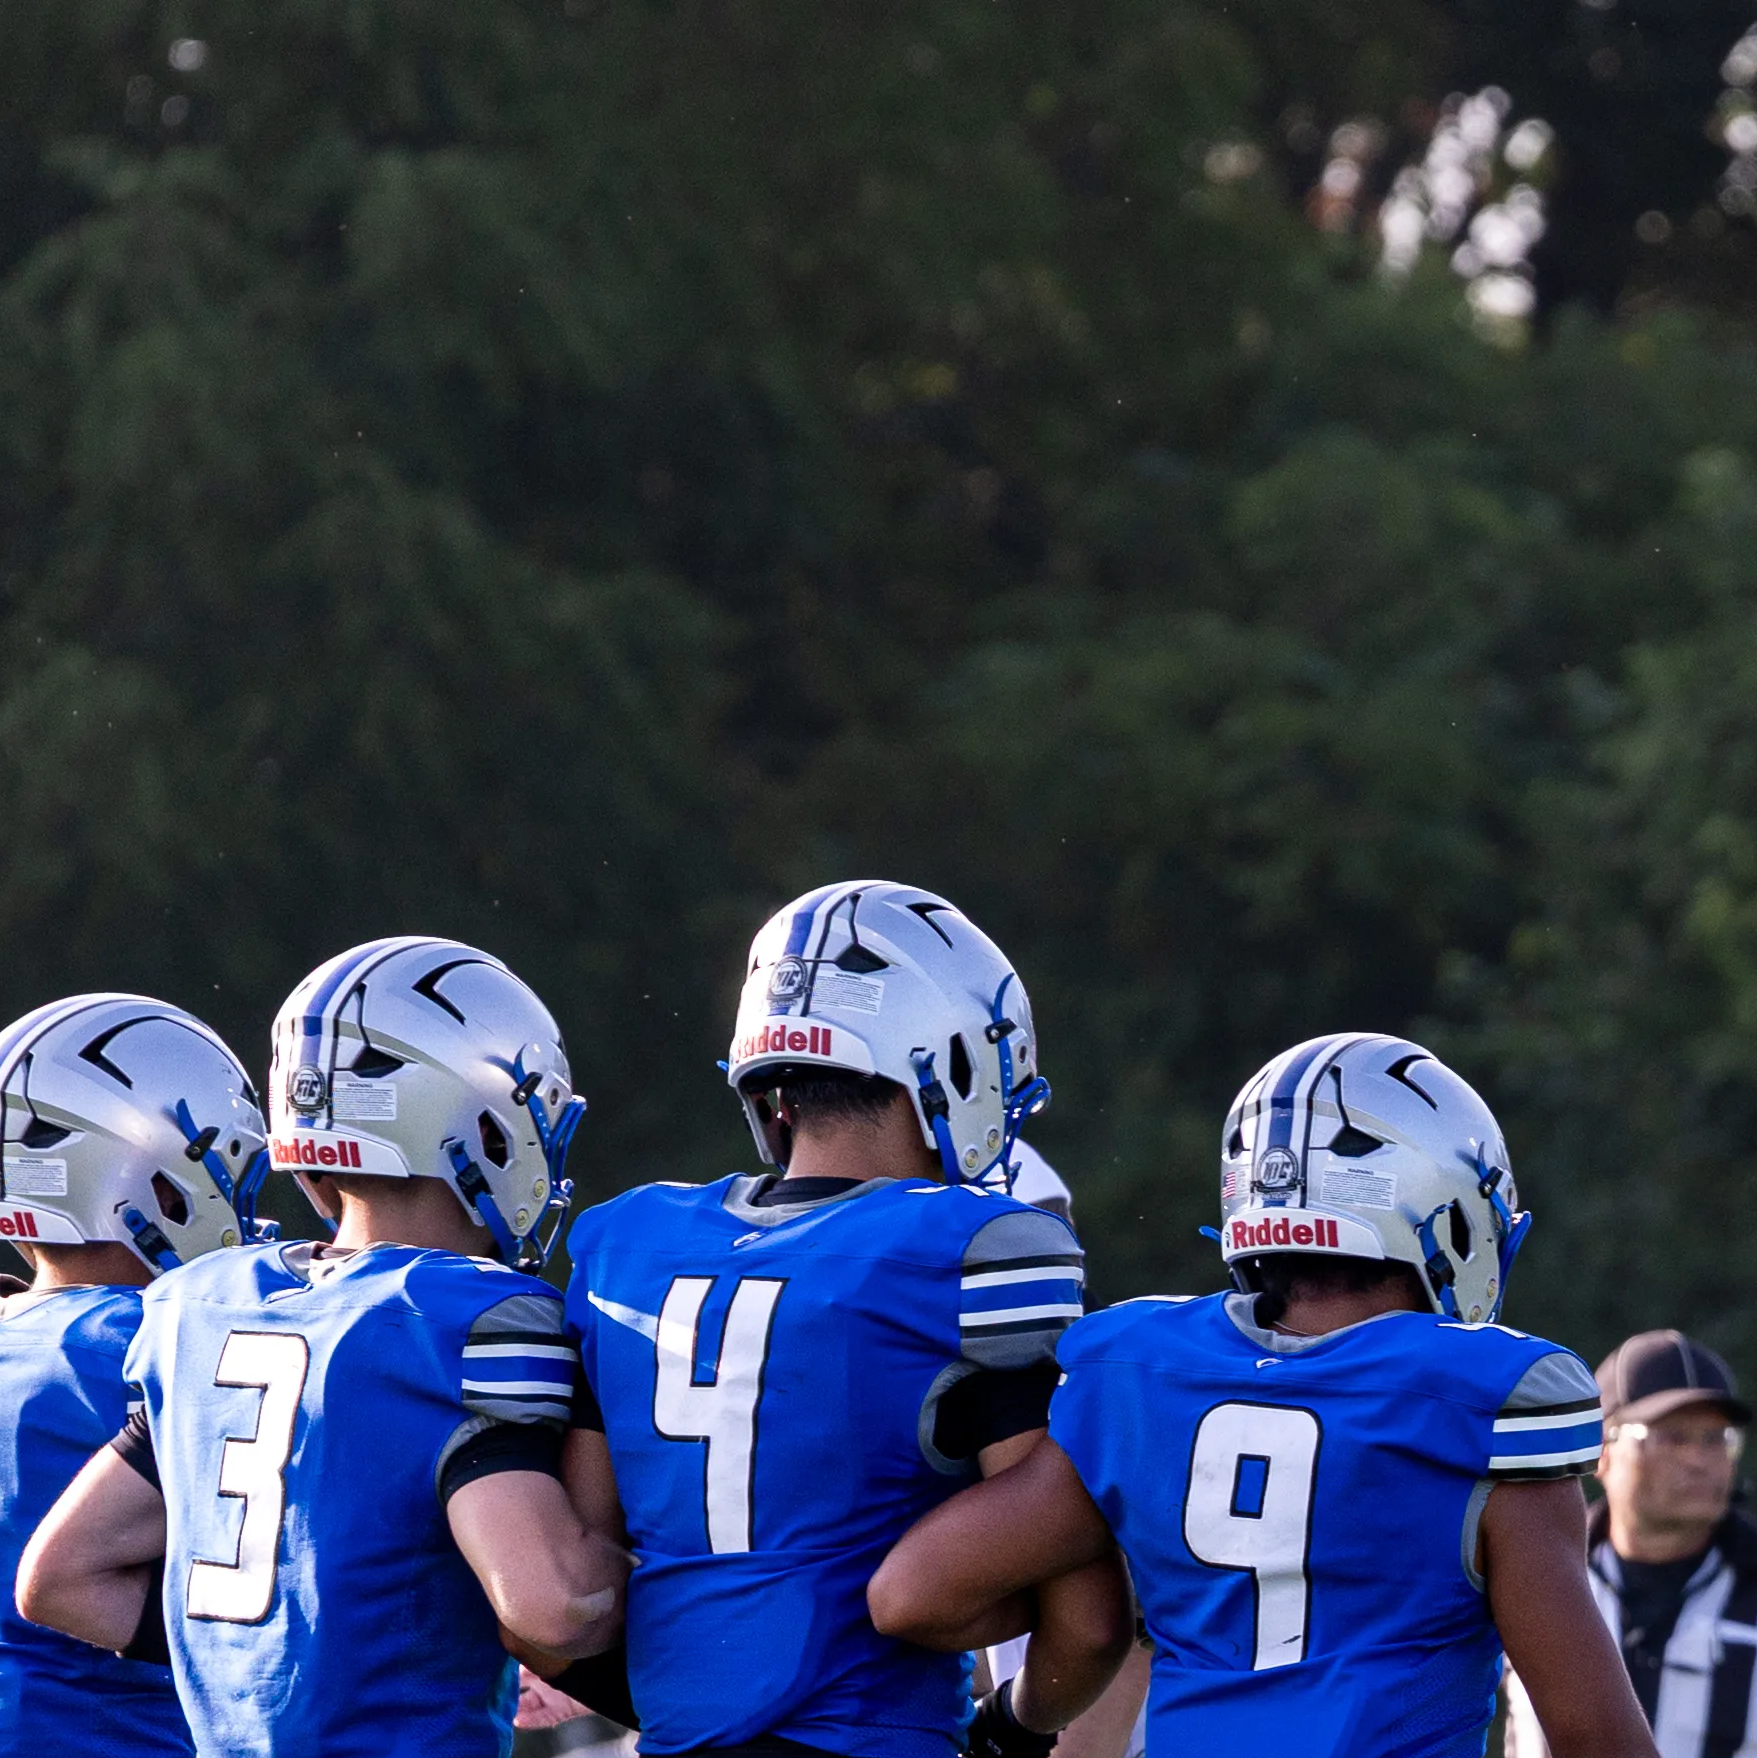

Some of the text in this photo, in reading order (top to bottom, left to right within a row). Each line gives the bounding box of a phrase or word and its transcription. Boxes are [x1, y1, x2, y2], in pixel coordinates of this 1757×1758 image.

[1231, 1217, 1340, 1249] Riddell
[185, 1330, 309, 1625] 3
[653, 1275, 789, 1555] 4
[1183, 1401, 1323, 1672] 9
